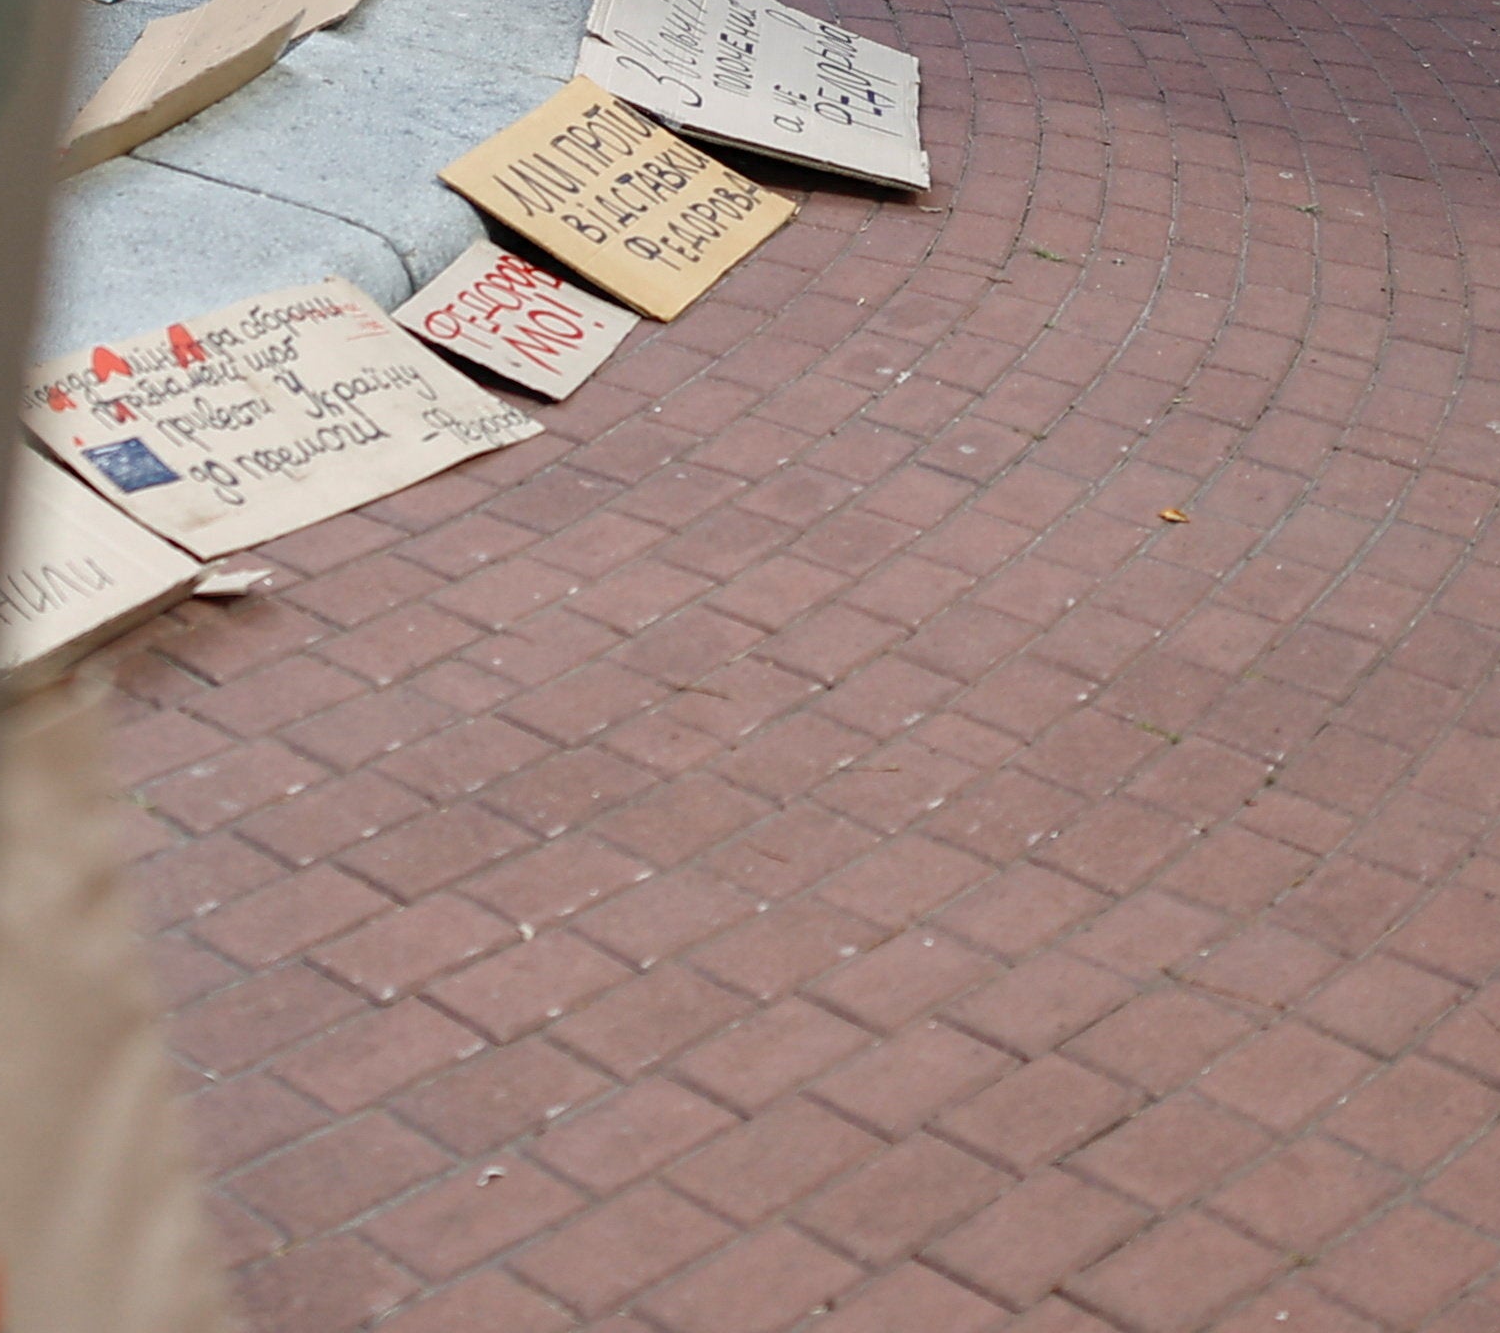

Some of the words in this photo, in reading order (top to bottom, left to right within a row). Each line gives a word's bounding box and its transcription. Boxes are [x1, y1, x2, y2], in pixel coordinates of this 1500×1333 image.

[493, 152, 587, 217] МИ
[551, 100, 660, 176] ПРОТИ
[560, 141, 710, 245] ВІДСТАВКИ
[623, 170, 770, 271] ФЕДОРОВА
